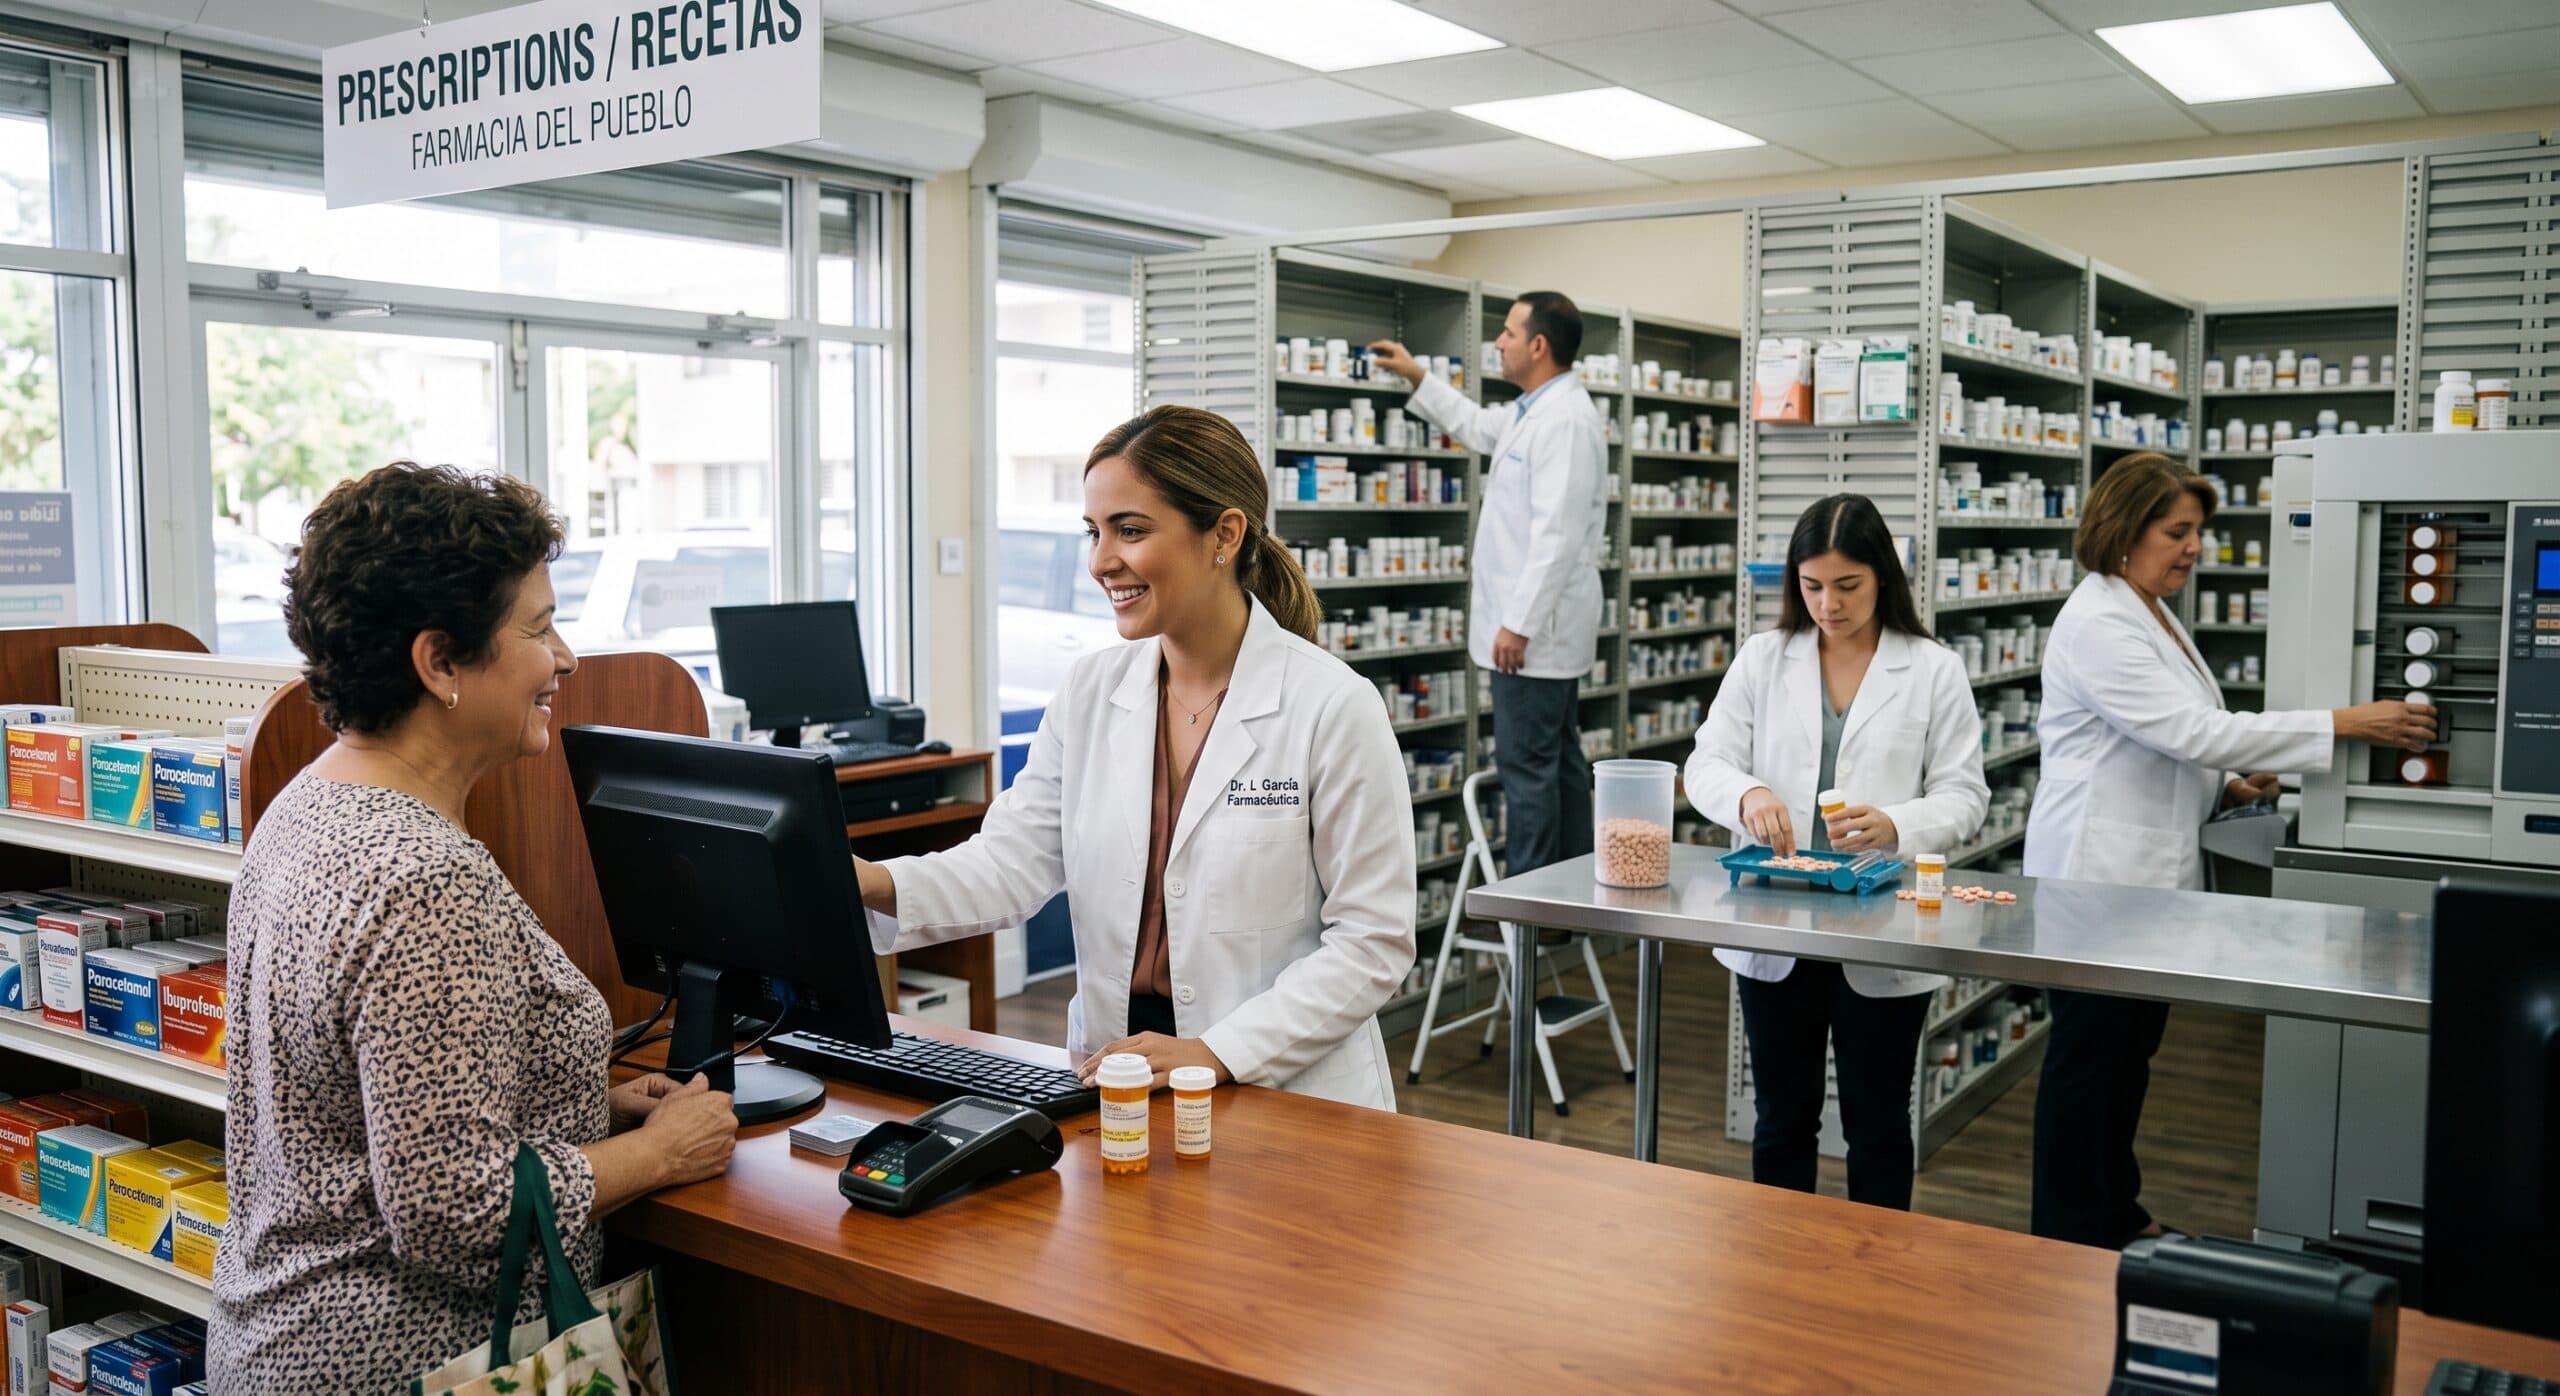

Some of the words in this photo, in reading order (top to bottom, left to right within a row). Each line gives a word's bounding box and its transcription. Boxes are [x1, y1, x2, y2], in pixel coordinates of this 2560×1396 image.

[338, 24, 594, 126] PRESCRIPTIONS
[606, 16, 620, 82] /
[631, 0, 801, 71] RECETAS
[412, 112, 528, 170] FARMACIA
[536, 106, 581, 150] DEL
[591, 85, 692, 144] PUEBLO
[1227, 793, 1300, 806] Farmacéutica
[1230, 779, 1246, 791] Dr.
[1262, 777, 1299, 791] García
[162, 985, 224, 1020] Ibuprofeno
